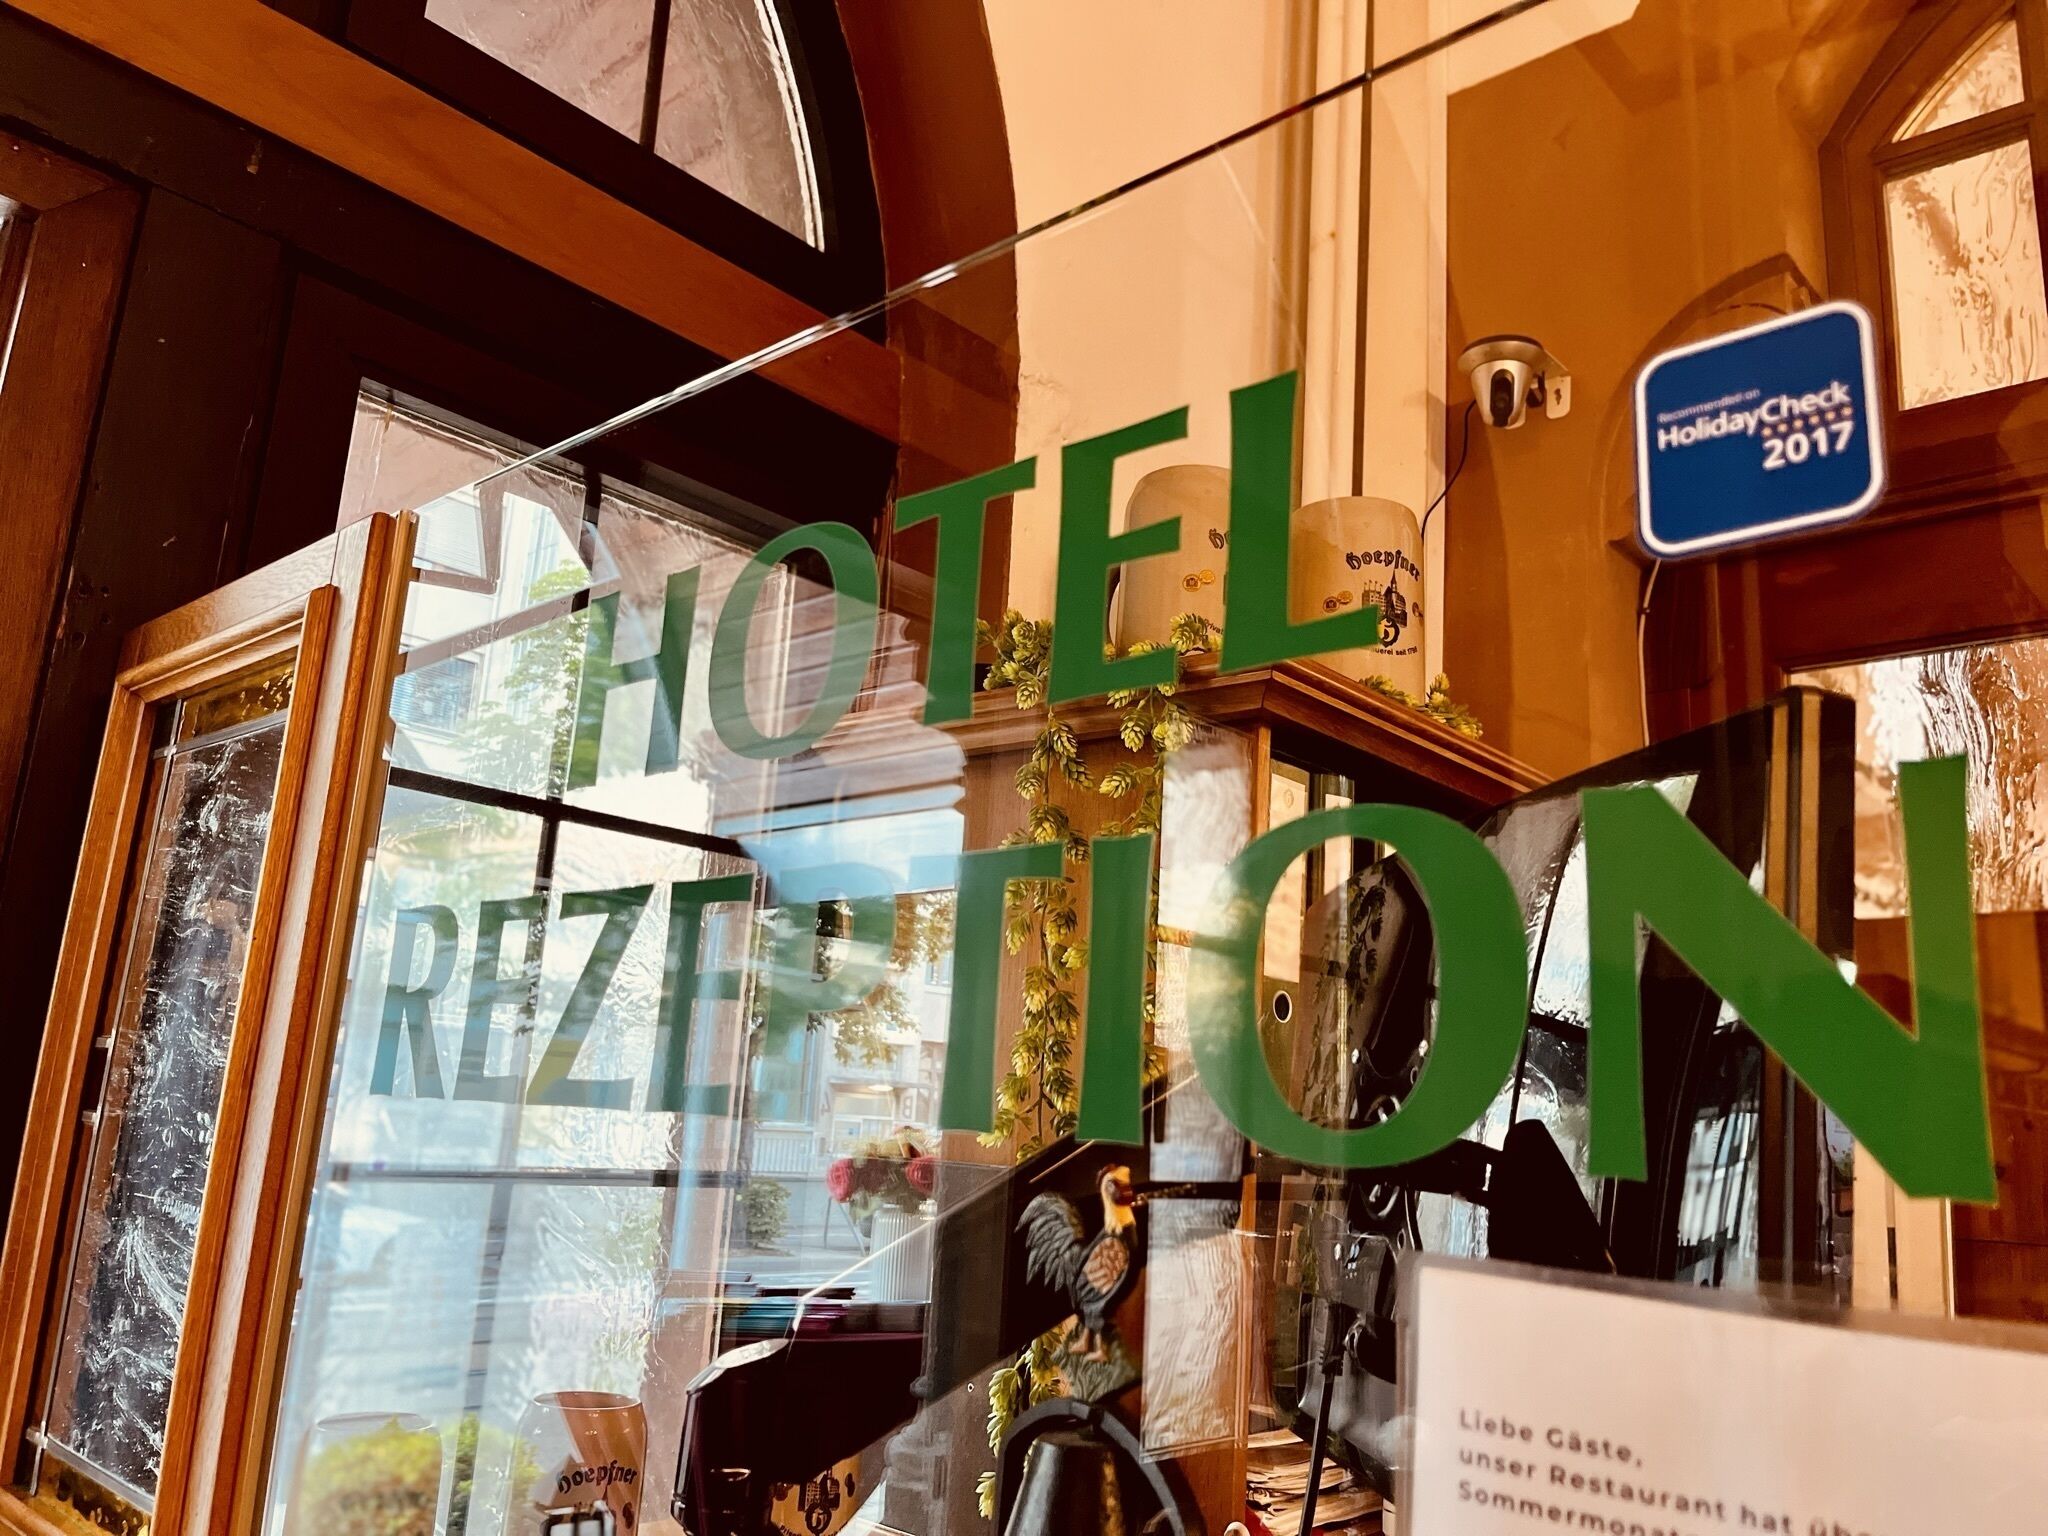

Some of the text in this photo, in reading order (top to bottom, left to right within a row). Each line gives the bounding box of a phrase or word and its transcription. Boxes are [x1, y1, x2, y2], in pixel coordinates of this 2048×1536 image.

[1656, 380, 1852, 453] HolidayCheck
[1762, 419, 1855, 471] 2017
[566, 370, 1380, 791] HOTEL
[369, 754, 1998, 1207] REZEPTION
[1459, 1407, 1644, 1469] Liebe Gäste,
[1459, 1449, 1537, 1479] unser
[1549, 1464, 1726, 1522] Restaurant
[1740, 1503, 1791, 1536] hat
